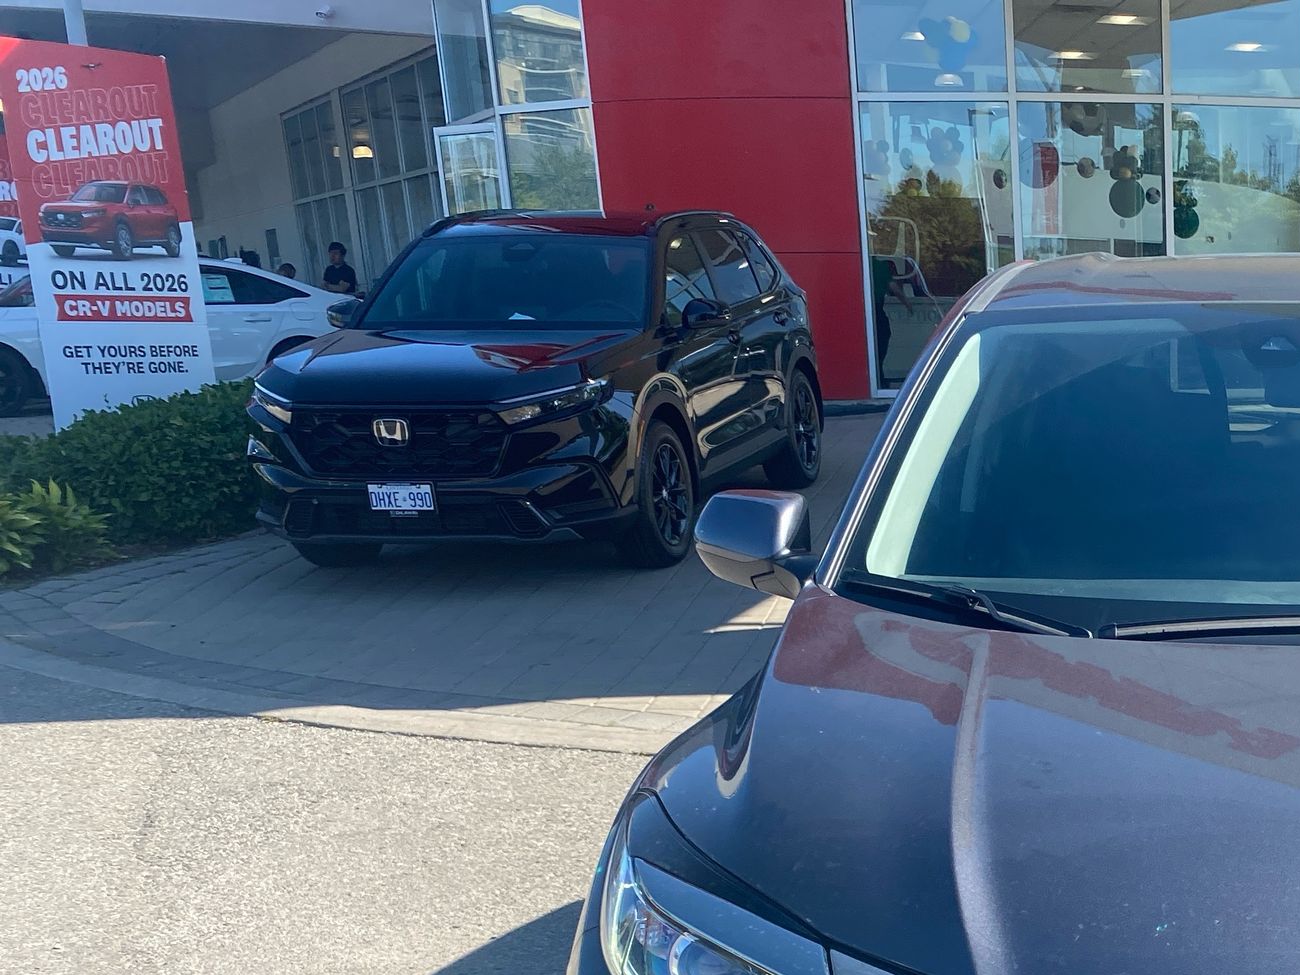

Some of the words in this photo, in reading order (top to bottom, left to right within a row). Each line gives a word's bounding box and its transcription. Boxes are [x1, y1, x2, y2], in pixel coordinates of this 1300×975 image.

[16, 66, 68, 92] 2026
[20, 84, 158, 129] CLEAROUT
[26, 118, 164, 164] CLEAROUT
[51, 270, 87, 290] ON
[94, 271, 136, 291] ALL
[140, 272, 189, 293] 2026
[63, 299, 111, 317] CR-V
[115, 300, 186, 318] MODELS
[62, 345, 93, 358] GET
[97, 345, 147, 358] YOURS
[149, 345, 199, 357] BEFORE
[81, 361, 145, 374] THEY'RE
[148, 361, 189, 373] GONE.
[369, 491, 402, 508] DHXE
[408, 491, 433, 508] 990
